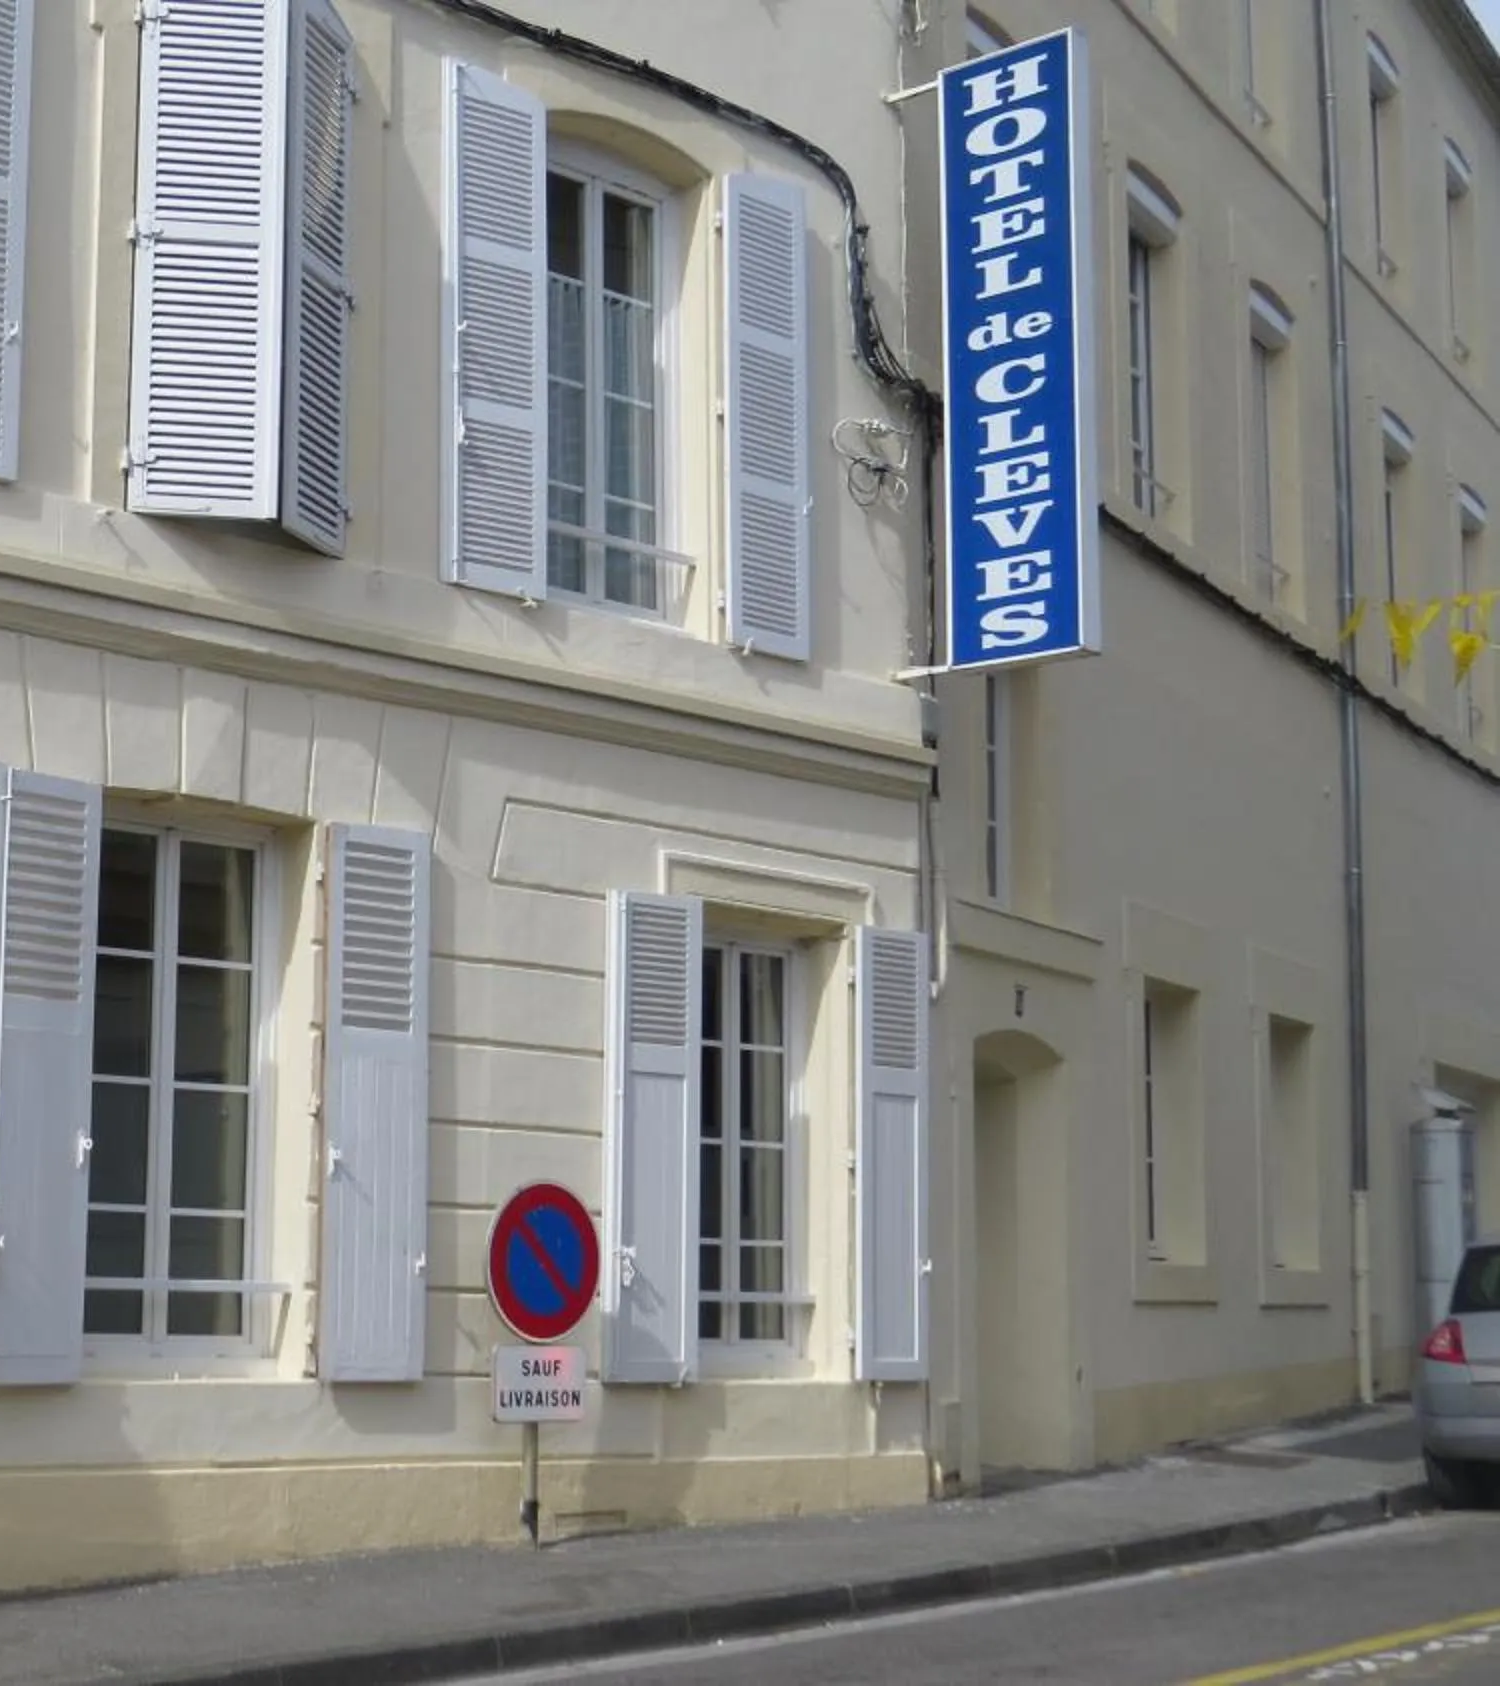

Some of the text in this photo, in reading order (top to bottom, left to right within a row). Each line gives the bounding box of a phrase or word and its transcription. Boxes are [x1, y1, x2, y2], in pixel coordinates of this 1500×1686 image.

[962, 53, 1055, 650] HOTEL de CLEVES
[521, 1359, 561, 1377] SAUF
[499, 1389, 581, 1409] LIVRAISON
